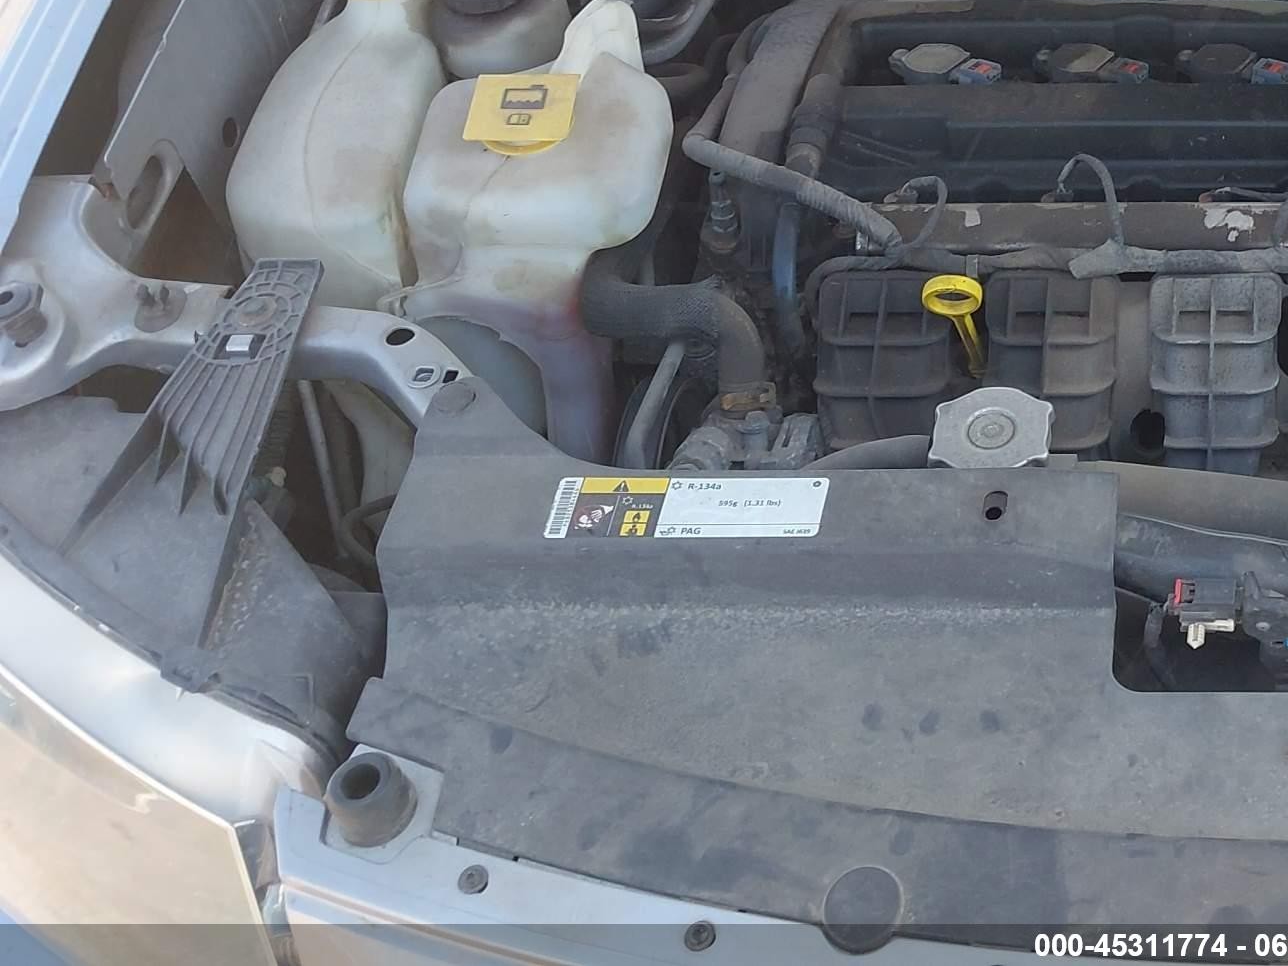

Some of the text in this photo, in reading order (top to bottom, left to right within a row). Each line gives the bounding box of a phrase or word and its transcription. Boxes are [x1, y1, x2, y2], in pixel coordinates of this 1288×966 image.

[687, 482, 722, 490] R-134a
[718, 499, 781, 508] 595g (1.31 lbs)
[680, 527, 701, 535] PAG
